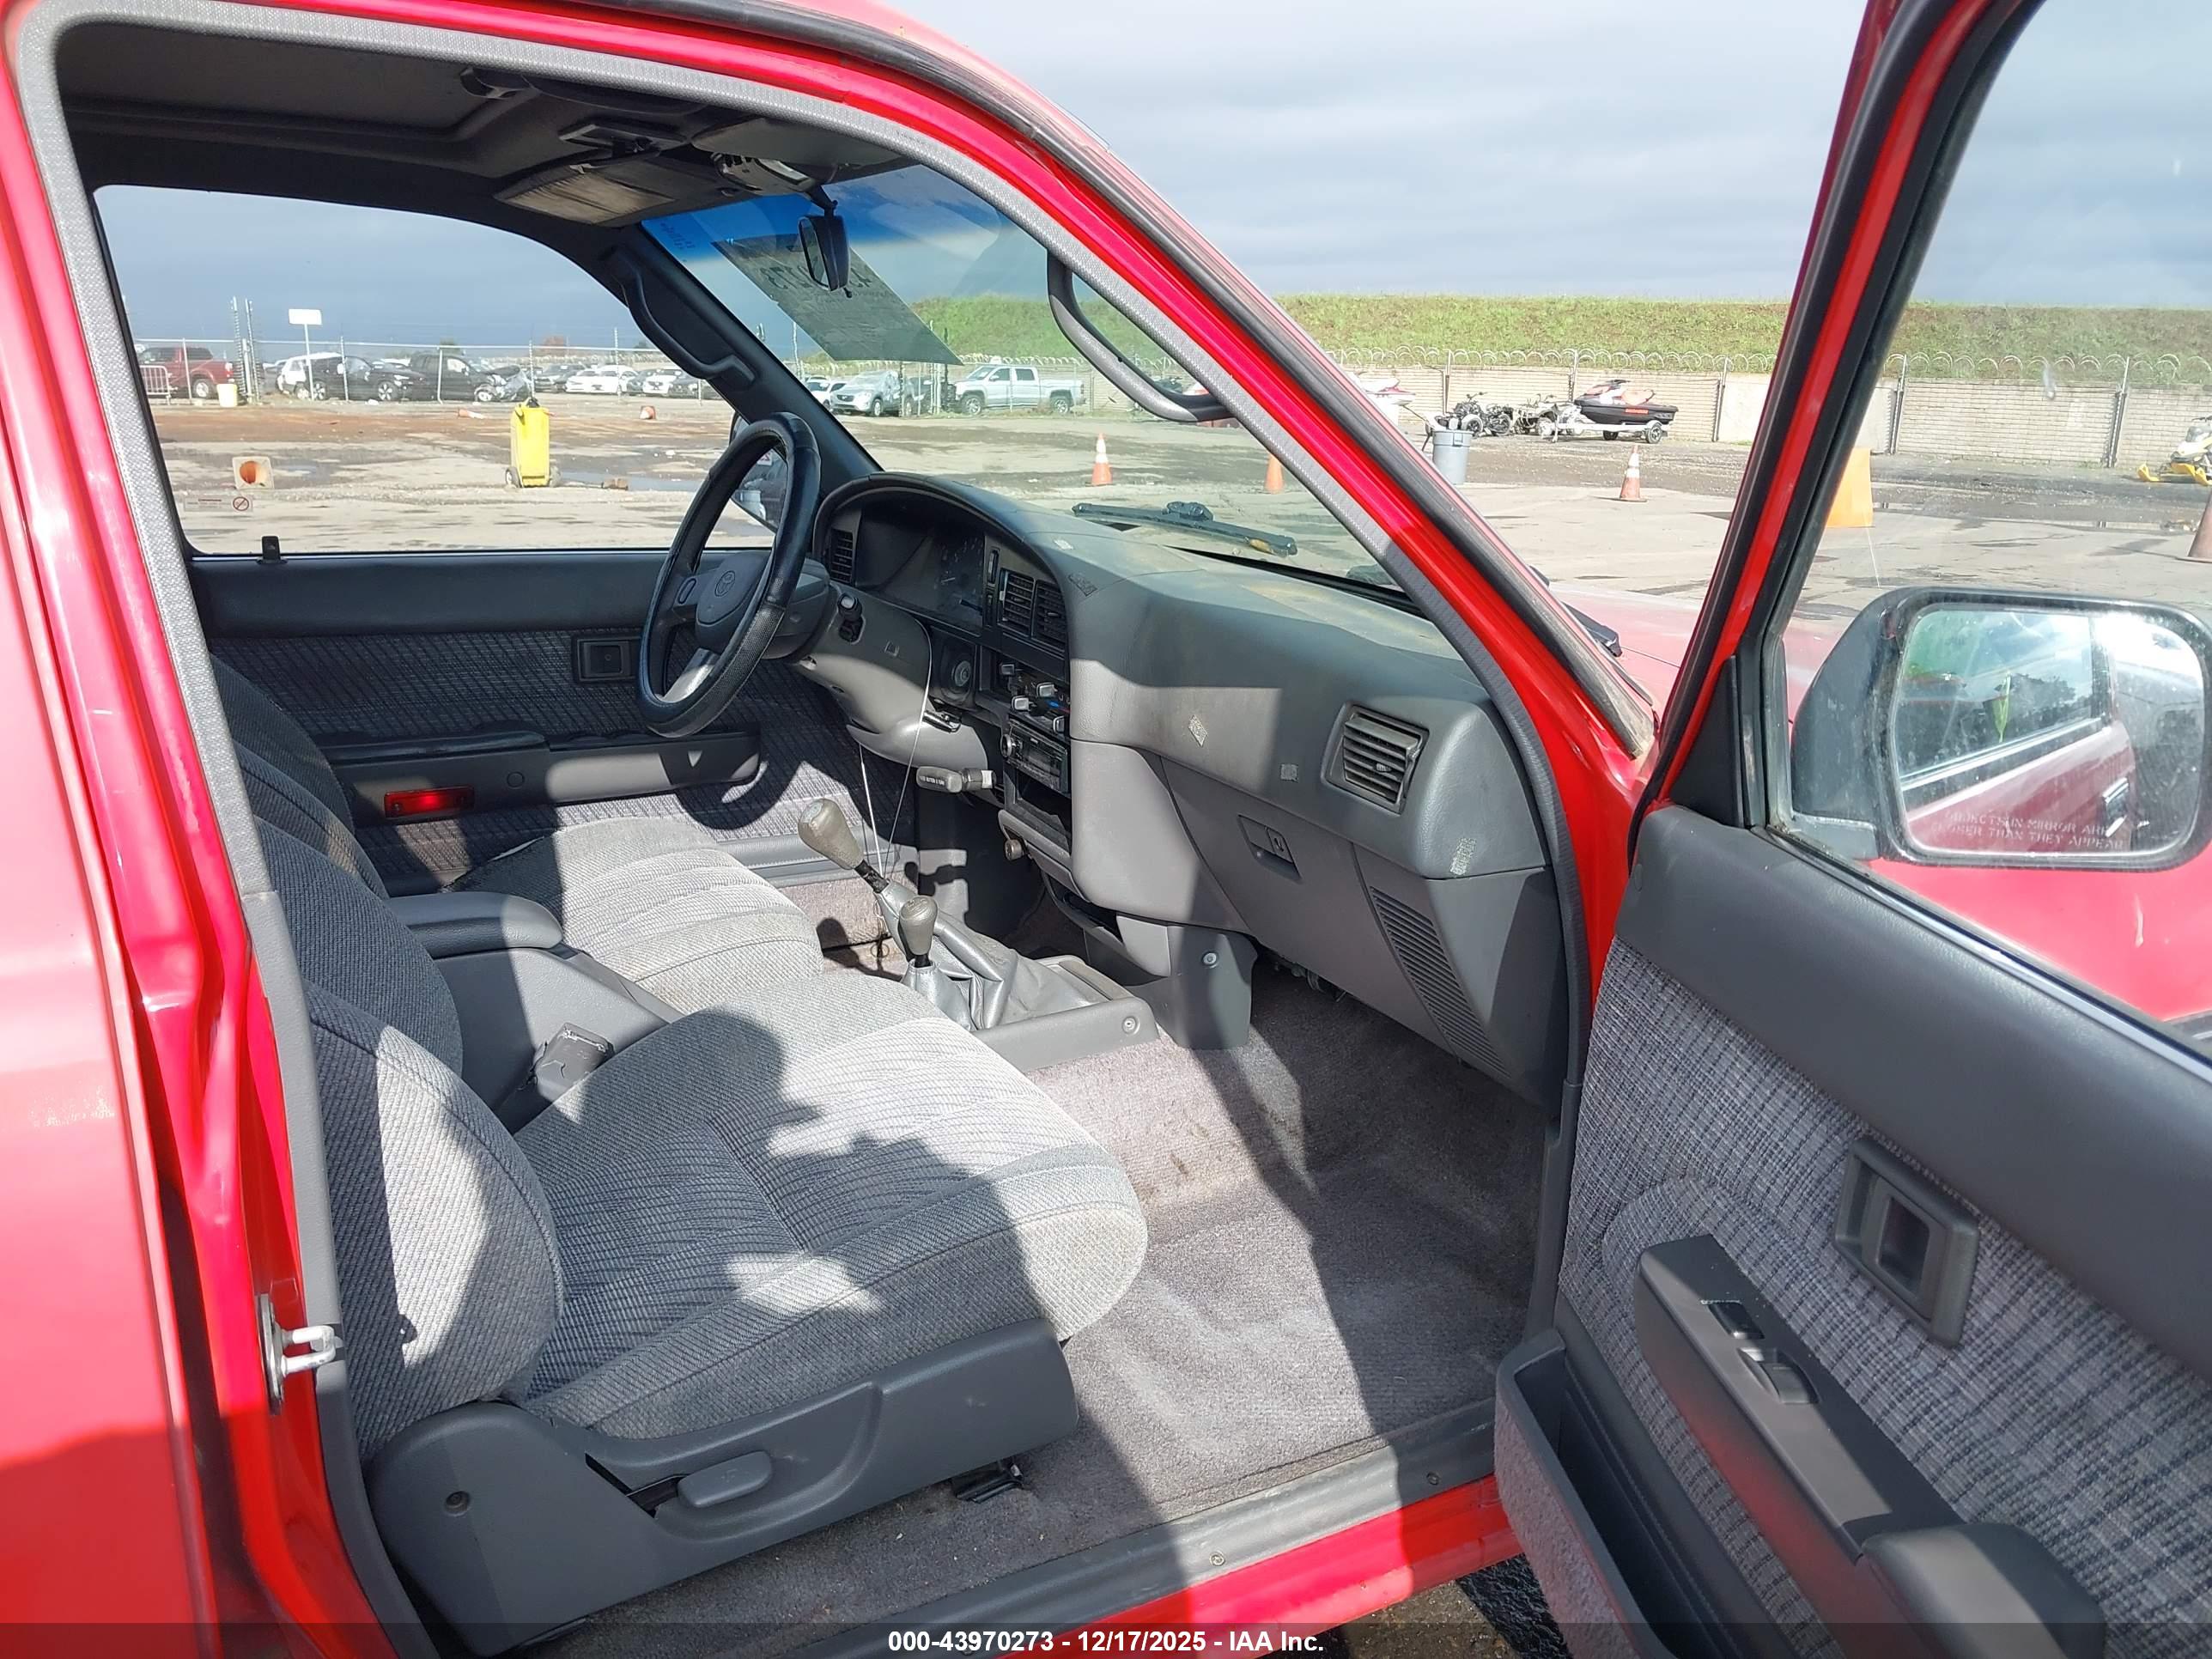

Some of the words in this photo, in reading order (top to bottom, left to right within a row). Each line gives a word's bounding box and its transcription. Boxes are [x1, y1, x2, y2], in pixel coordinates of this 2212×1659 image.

[2027, 819, 2076, 832] MIRROR
[1989, 828, 2024, 840] THAN
[2029, 831, 2063, 845] THEY
[2069, 836, 2124, 850] APPEAR
